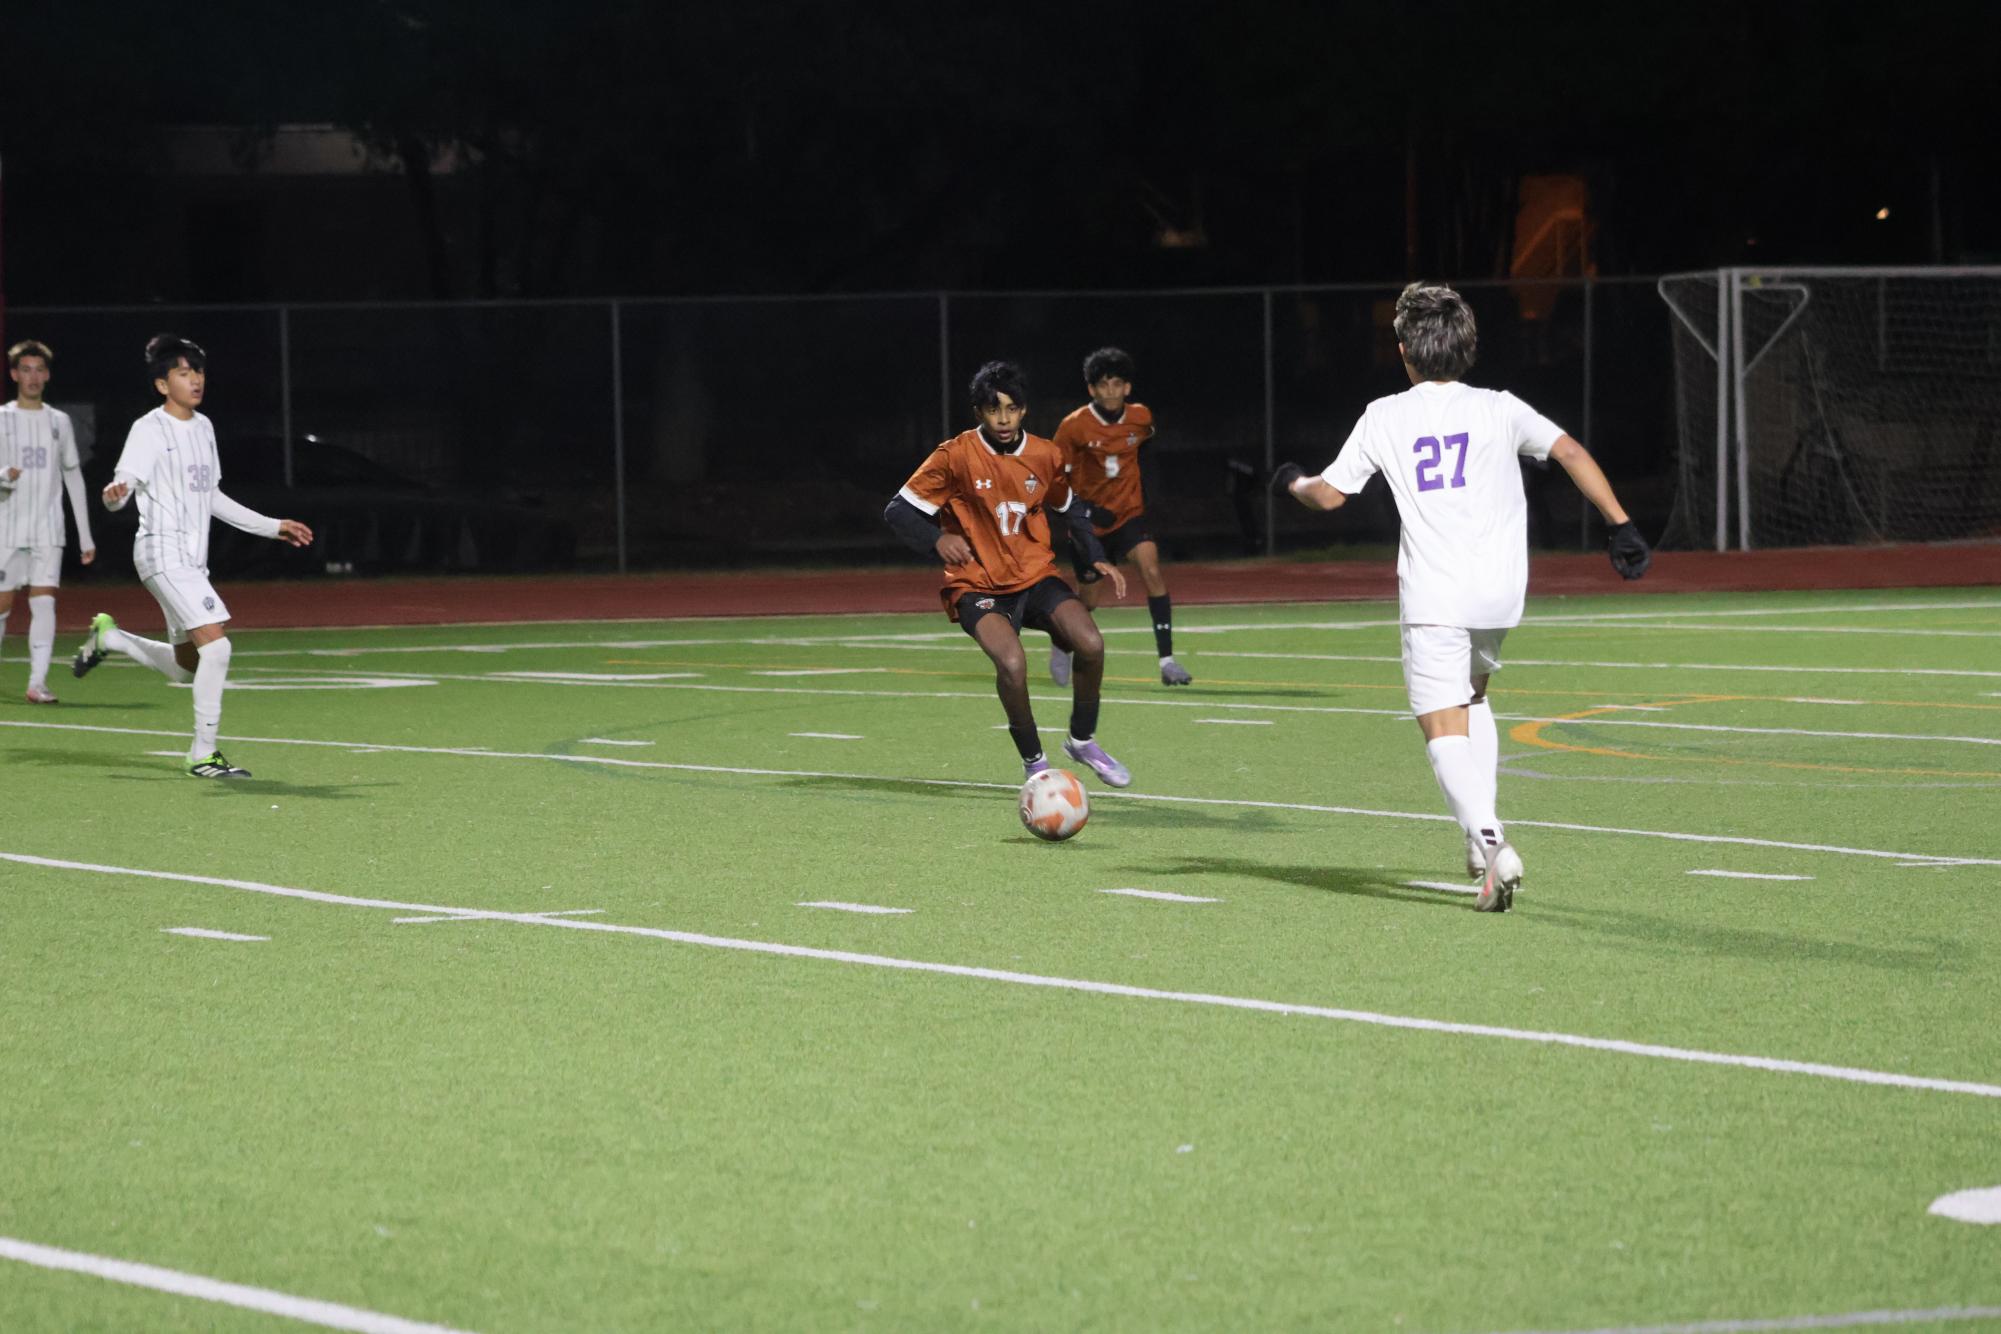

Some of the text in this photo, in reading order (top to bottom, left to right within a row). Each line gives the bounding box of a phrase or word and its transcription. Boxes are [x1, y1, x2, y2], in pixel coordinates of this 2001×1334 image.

[22, 446, 47, 469] 28
[1413, 432, 1469, 492] 27
[188, 464, 210, 493] 38
[996, 501, 1028, 537] 17
